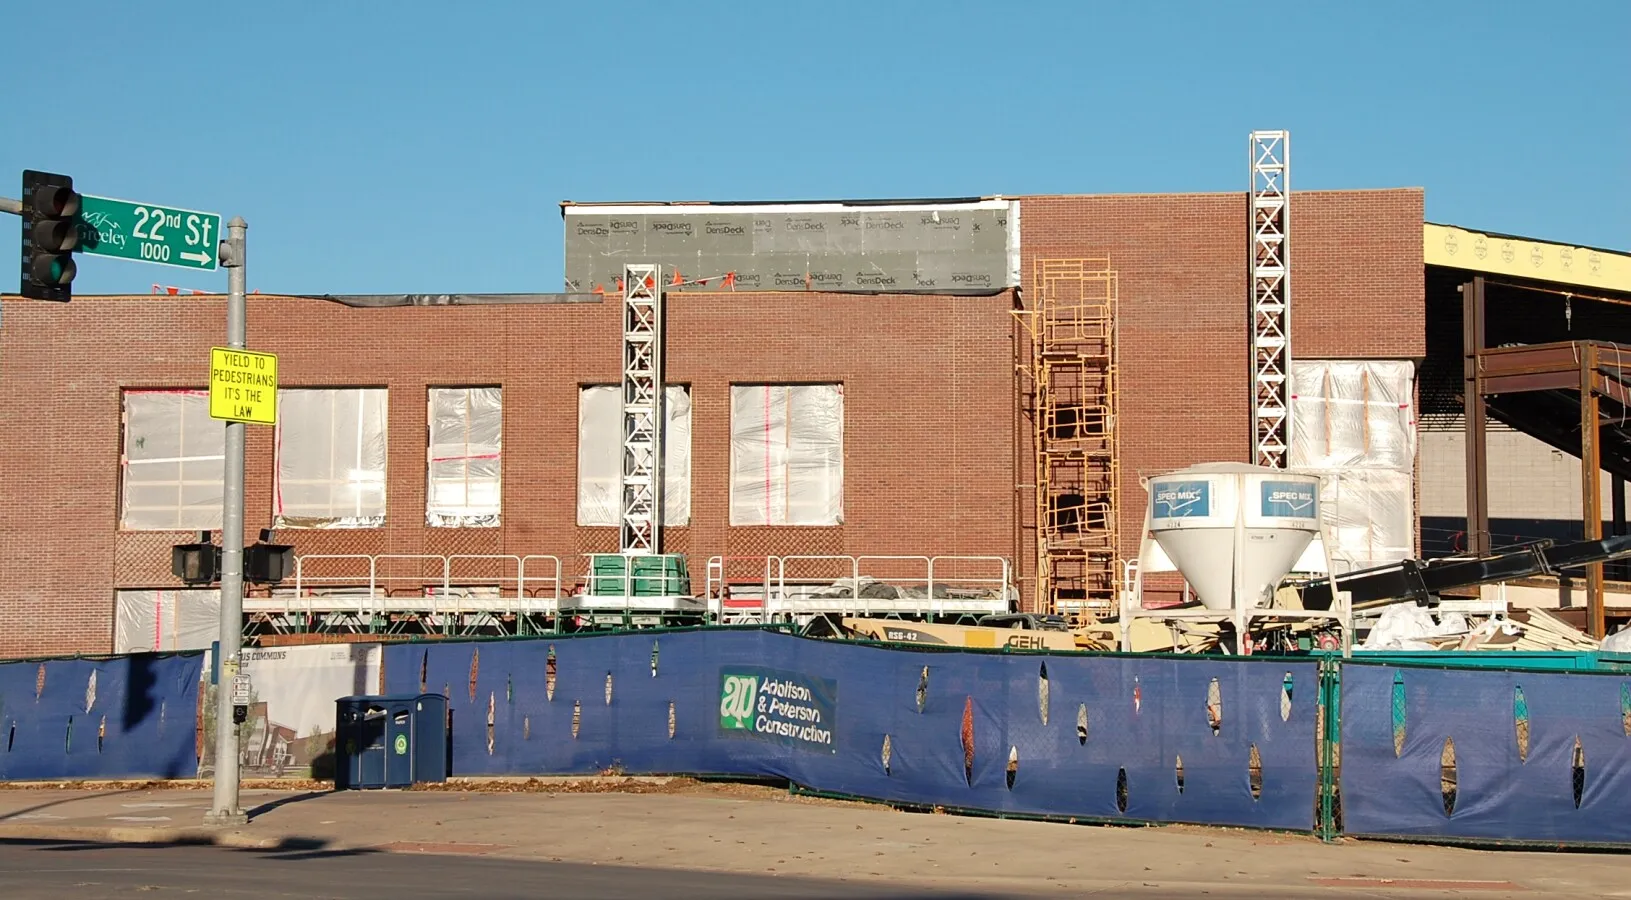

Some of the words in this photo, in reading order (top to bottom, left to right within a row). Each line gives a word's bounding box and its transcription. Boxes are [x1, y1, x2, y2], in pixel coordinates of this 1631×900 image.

[132, 206, 181, 241] 22nd
[185, 214, 212, 248] St
[705, 225, 745, 235] DensDeck
[786, 222, 825, 231] DensDeck
[865, 221, 905, 230] DensDeck
[140, 242, 170, 262] 1000
[856, 276, 896, 285] DensDeck
[223, 353, 250, 368] YIELD
[254, 356, 265, 370] TO
[213, 368, 274, 387] PEDESTRIANS
[224, 387, 241, 400] IT'S
[245, 389, 262, 403] THE
[234, 404, 252, 418] LAW
[1157, 492, 1177, 501] SPEC
[1177, 491, 1197, 500] MIX
[1272, 491, 1298, 500] SPEC
[1298, 492, 1312, 501] MIX
[1008, 634, 1050, 649] GEHL
[251, 650, 287, 661] COMMONS
[759, 676, 812, 702] Adolfson
[757, 695, 767, 713] &
[768, 697, 821, 723] Peterson
[755, 714, 832, 745] Construction
